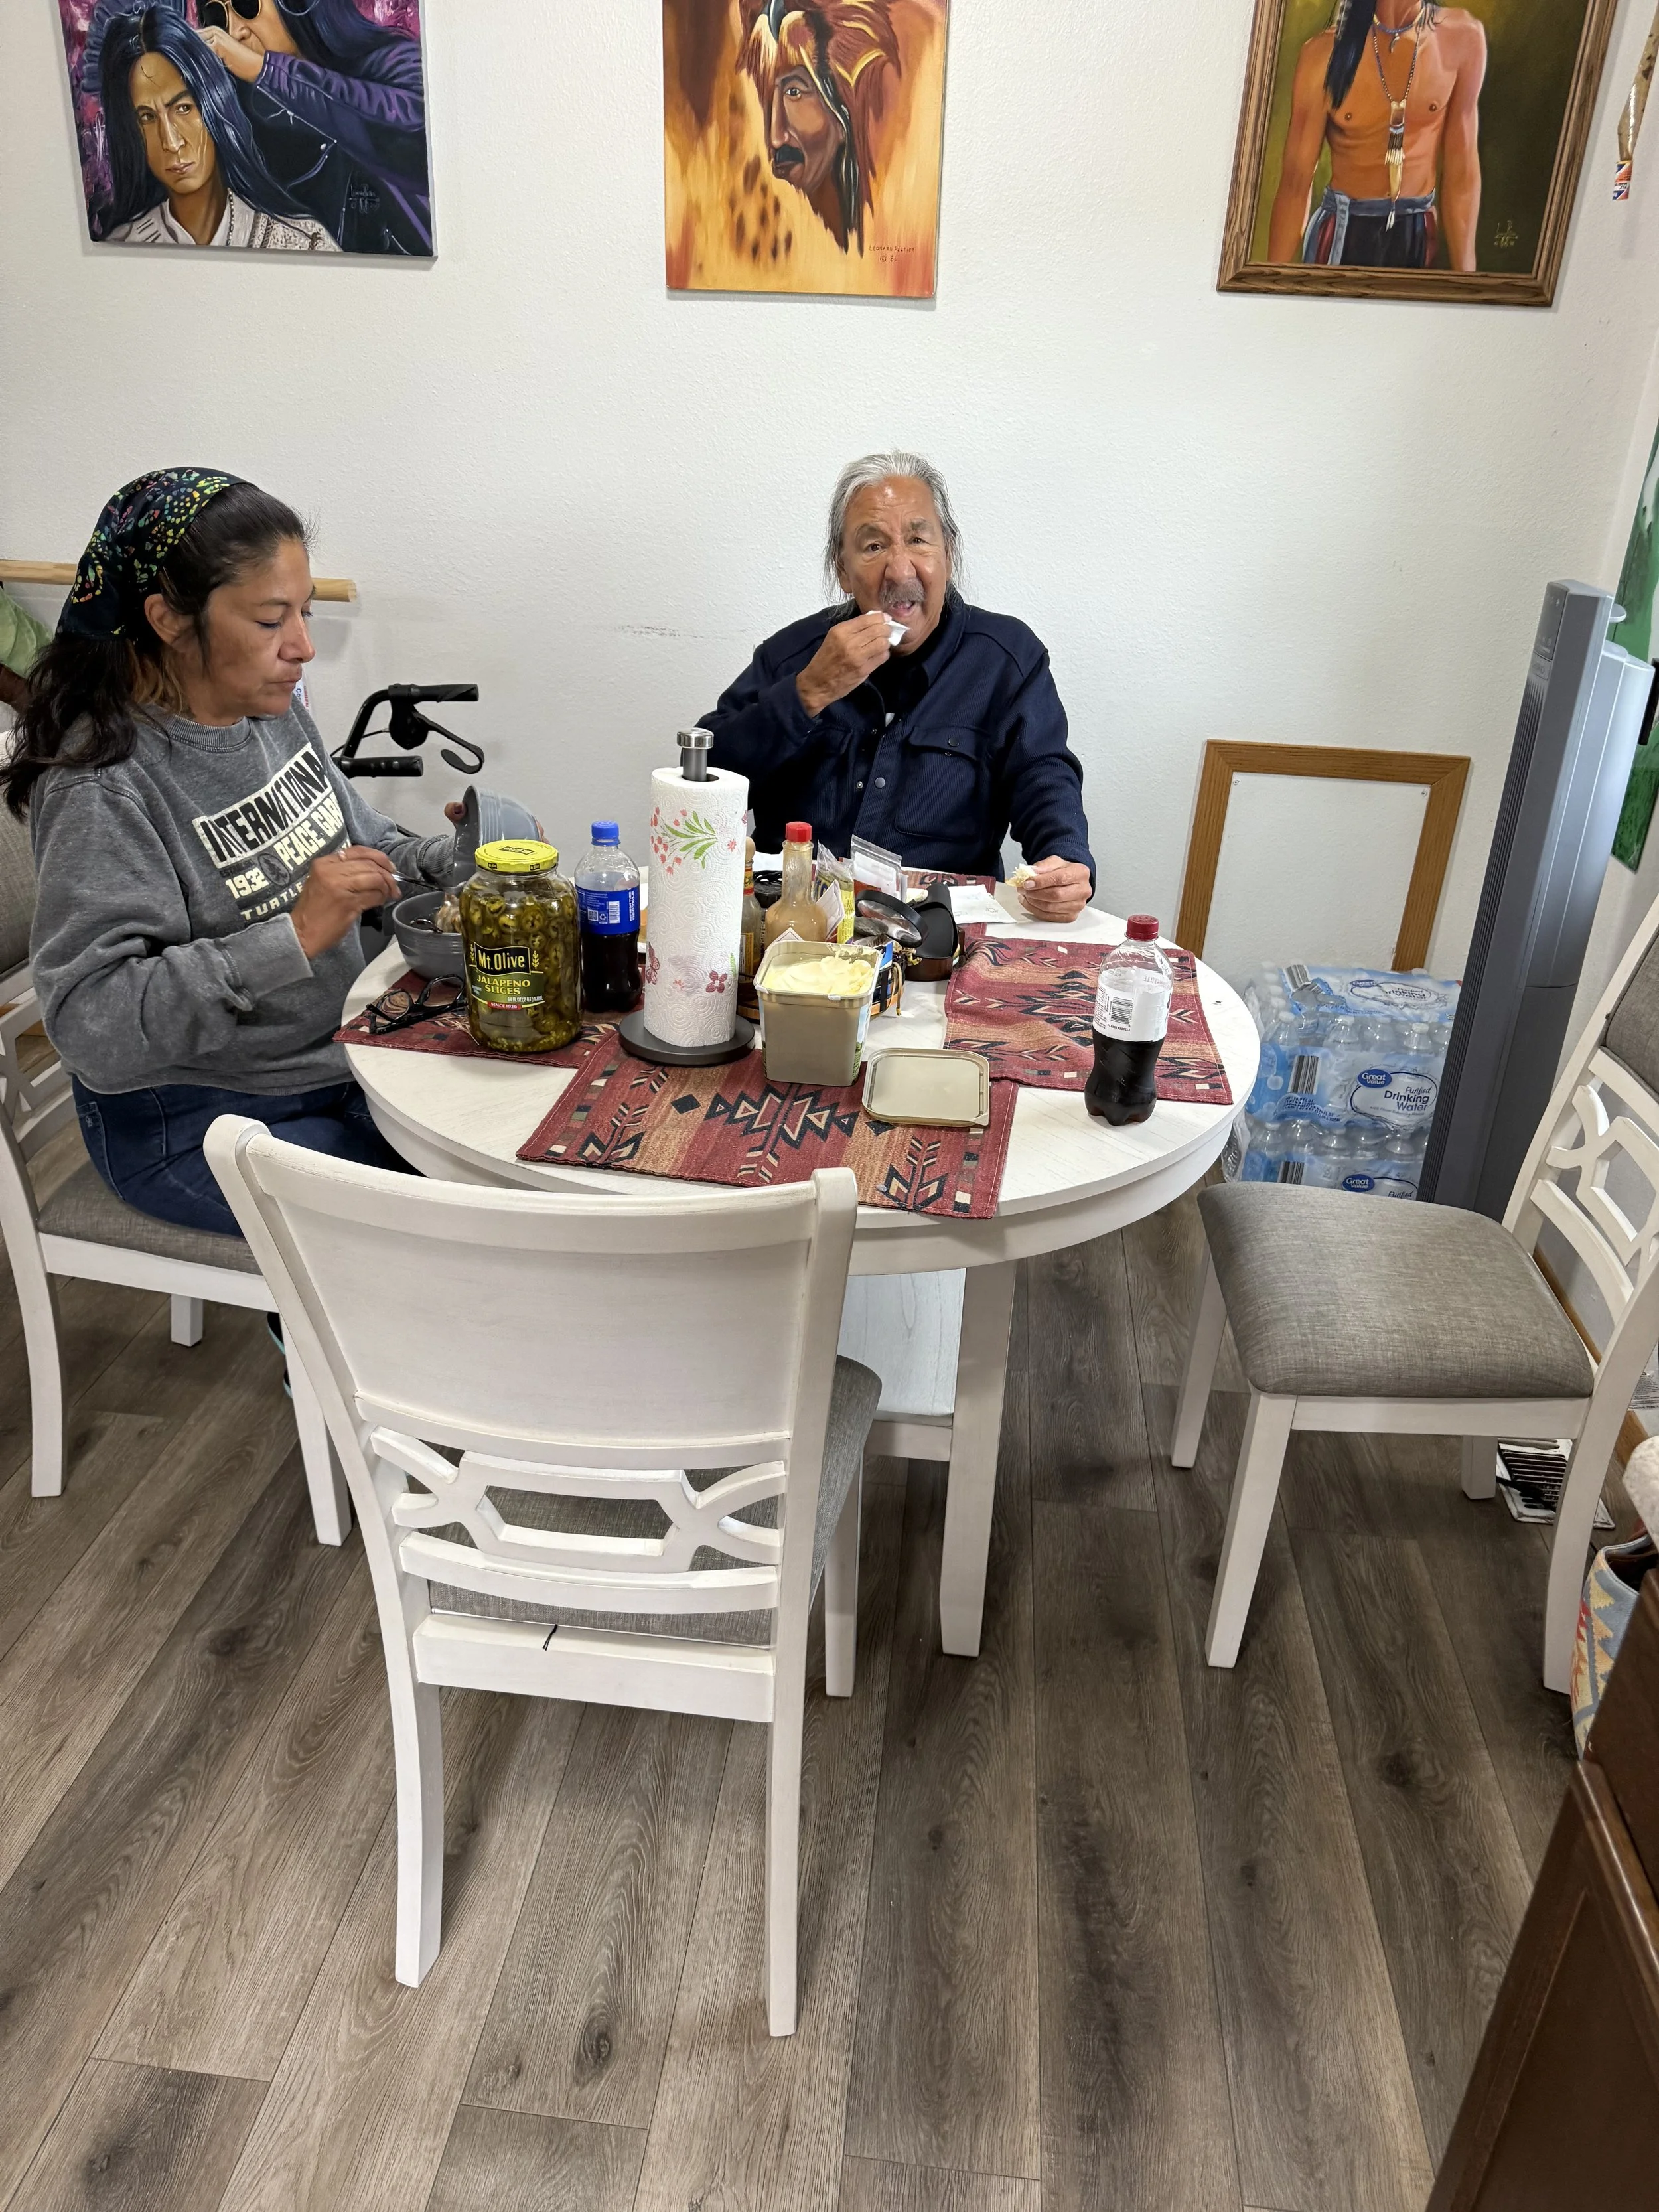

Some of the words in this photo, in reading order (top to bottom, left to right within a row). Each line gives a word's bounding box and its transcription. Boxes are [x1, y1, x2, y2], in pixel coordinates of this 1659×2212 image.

[273, 820, 326, 870] PEACE
[310, 792, 344, 838] GAR
[225, 867, 269, 899] 1932
[240, 881, 303, 921] TURTLE
[477, 975, 530, 987] JALAPENO
[484, 984, 521, 995] SLICES
[1384, 1090, 1429, 1104] Drinking
[1397, 1101, 1427, 1112] Water
